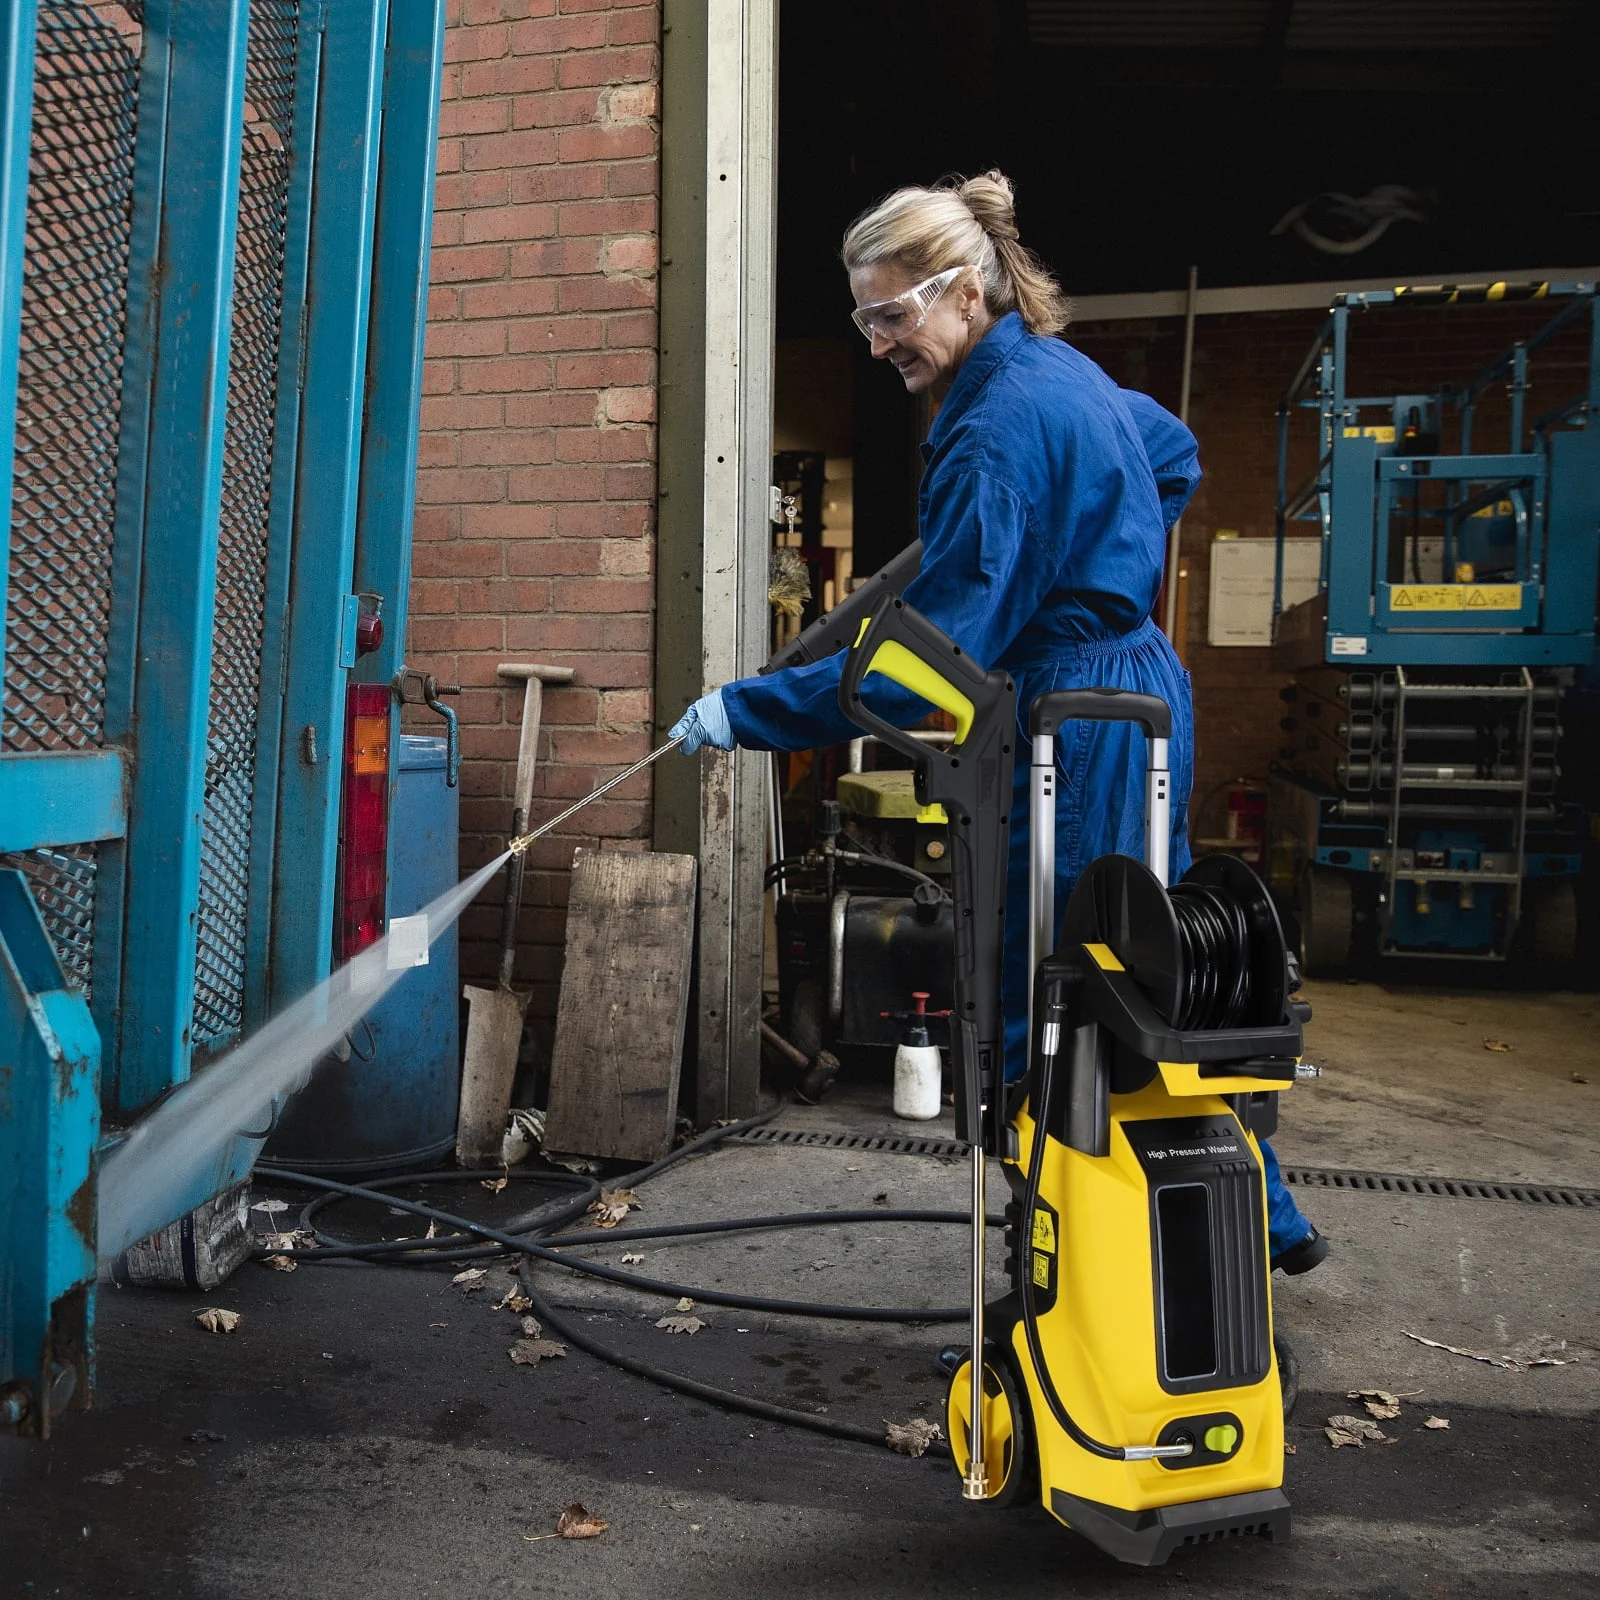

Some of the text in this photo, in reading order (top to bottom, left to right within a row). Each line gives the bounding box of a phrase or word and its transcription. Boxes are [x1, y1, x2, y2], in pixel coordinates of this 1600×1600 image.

[1147, 1144, 1238, 1159] High Pressure Washer
